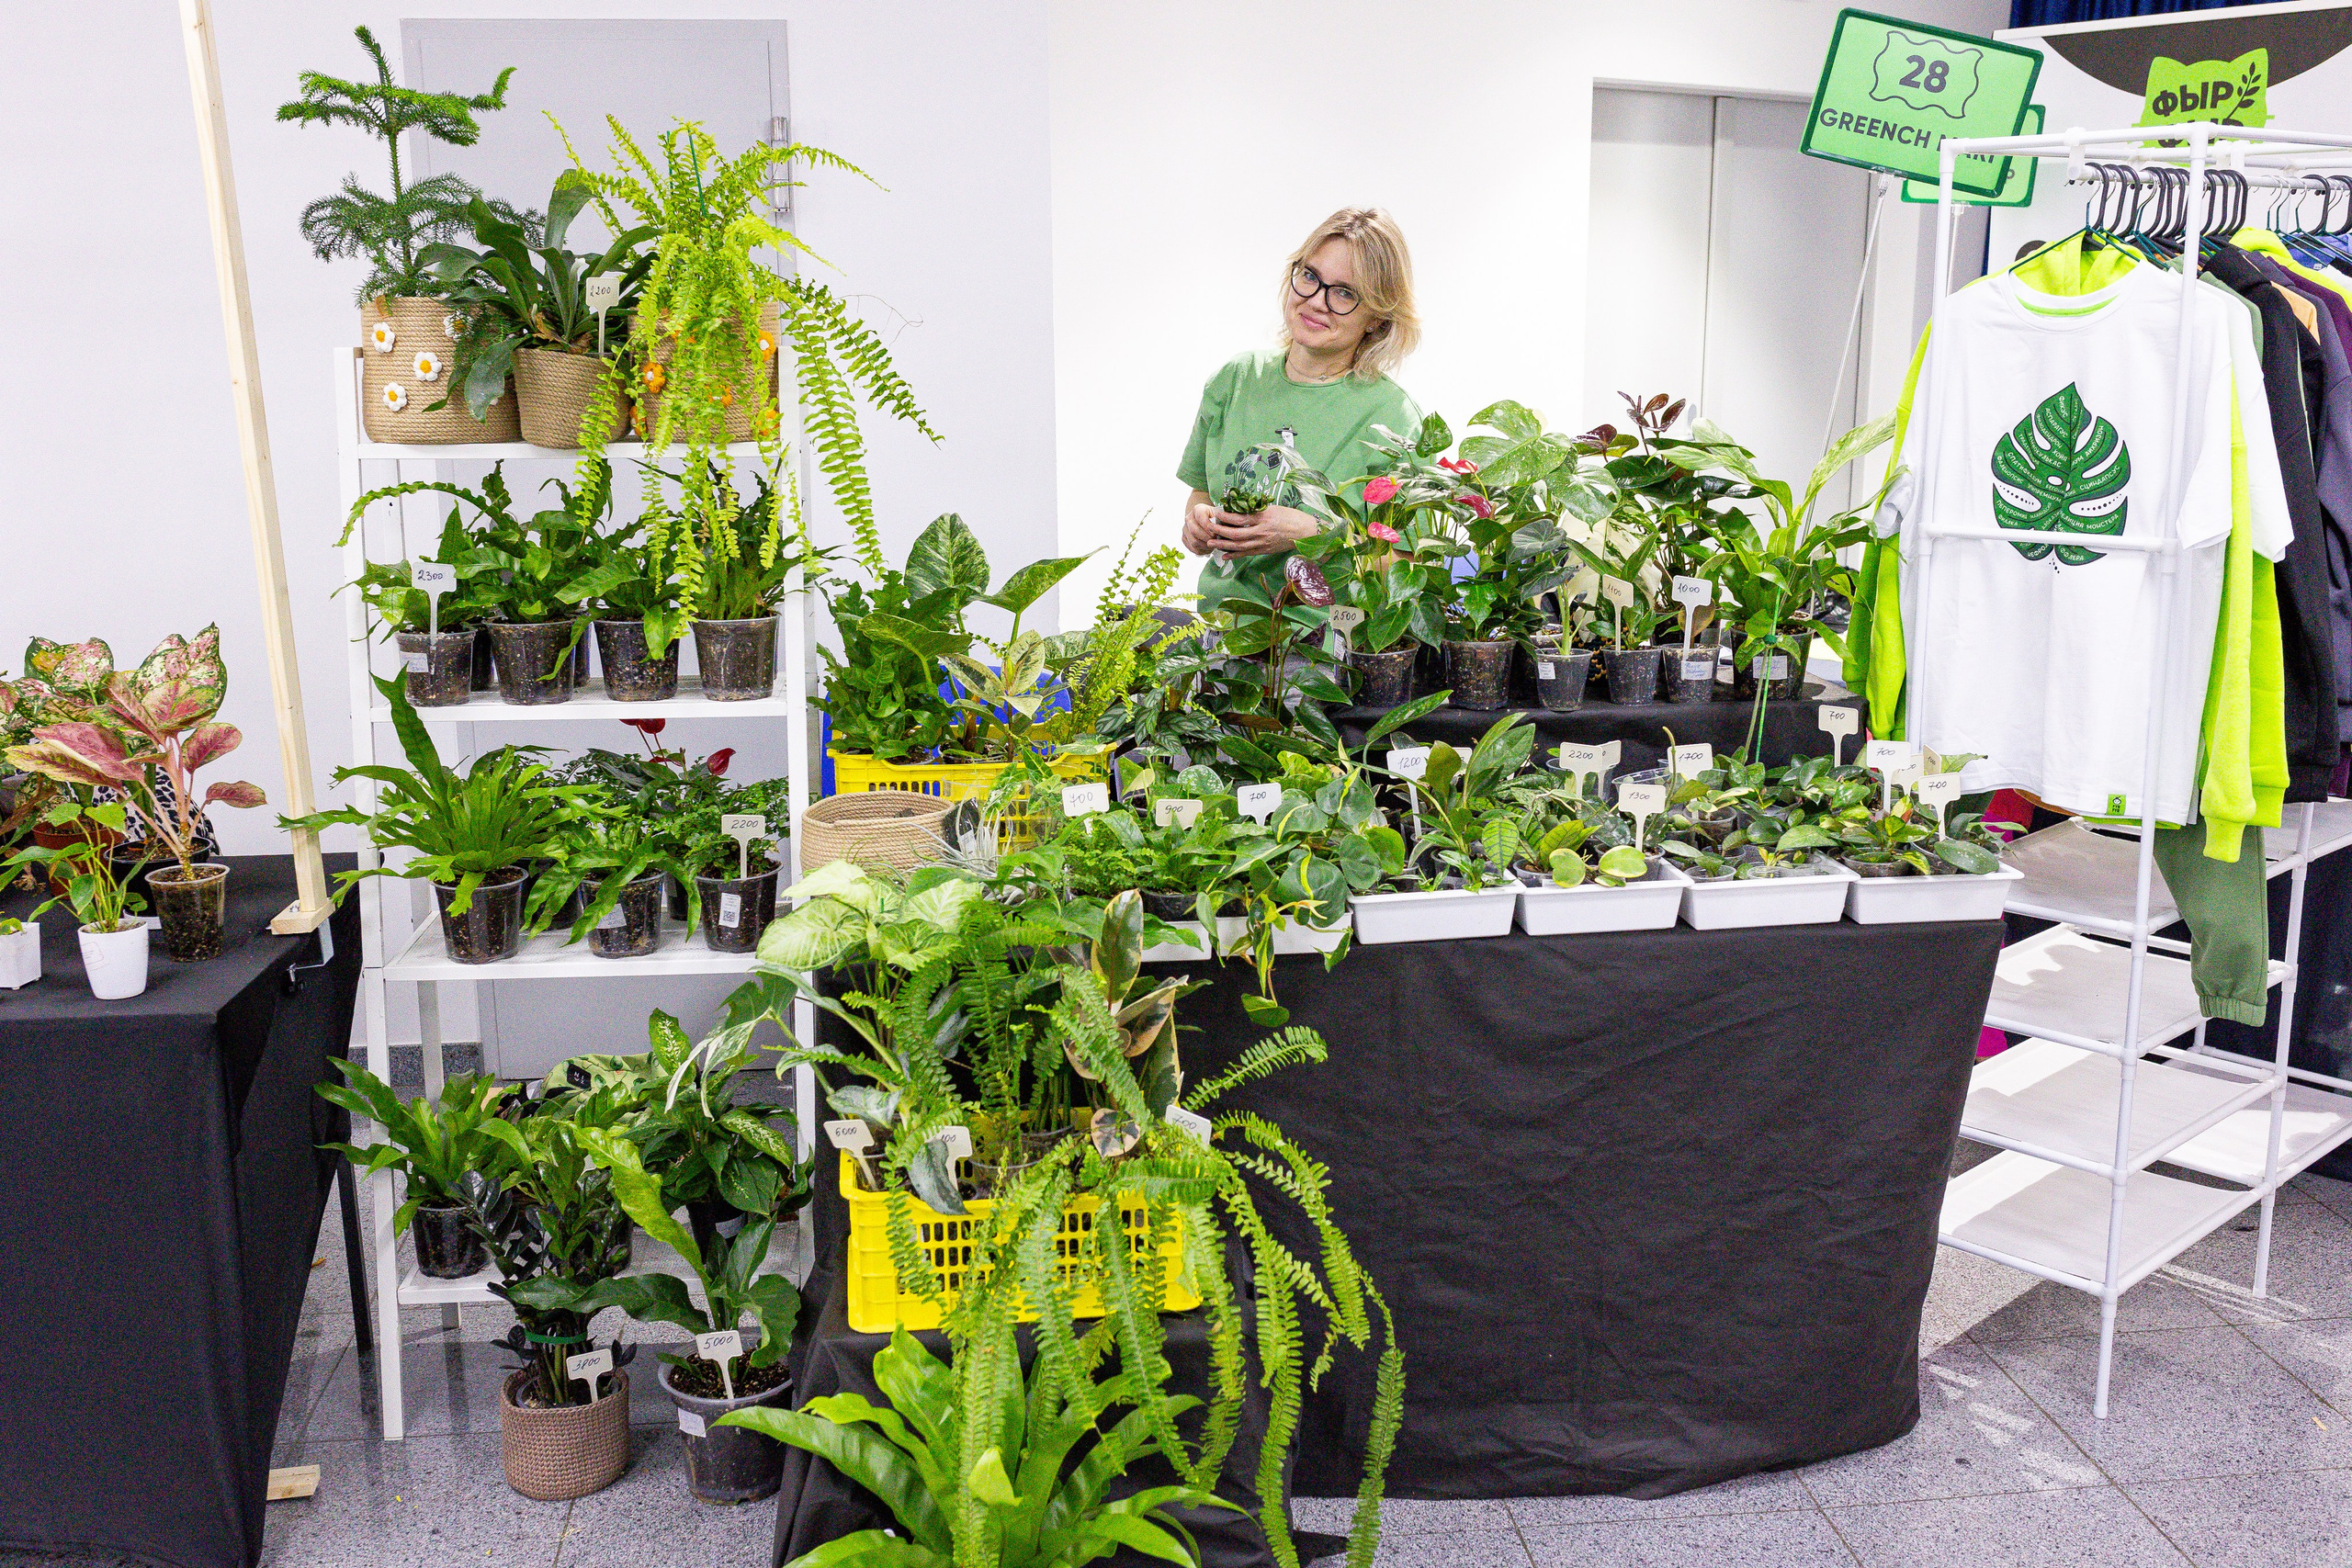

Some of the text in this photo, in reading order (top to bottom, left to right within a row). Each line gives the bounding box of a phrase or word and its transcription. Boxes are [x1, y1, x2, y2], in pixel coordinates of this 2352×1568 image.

[1899, 55, 1950, 93] 28
[2153, 81, 2234, 117] ФЫР
[1820, 107, 1931, 149] GREENCH
[2059, 396, 2068, 418] ФИКУС
[2045, 408, 2068, 438] АСПАРАГУС
[1996, 456, 2024, 483] ФАЛЕНОПСИС
[2079, 465, 2120, 490] СЦИНДАПСУС
[1998, 513, 2018, 526] ФИАЛКА
[2086, 513, 2120, 530] МОНСТЕРА
[418, 570, 444, 581] 2300
[1677, 582, 1701, 593] 1000
[1333, 610, 1357, 621] 2500
[1829, 711, 1846, 720] 700
[1568, 750, 1594, 760] 2200
[1679, 752, 1704, 761] 1700
[1877, 747, 1896, 757] 700
[1398, 757, 1421, 770] 1200
[1928, 781, 1948, 792] 700
[1250, 791, 1267, 802] 700
[1629, 792, 1651, 800] 1300
[731, 819, 759, 829] 2200
[703, 1336, 734, 1350] 5000
